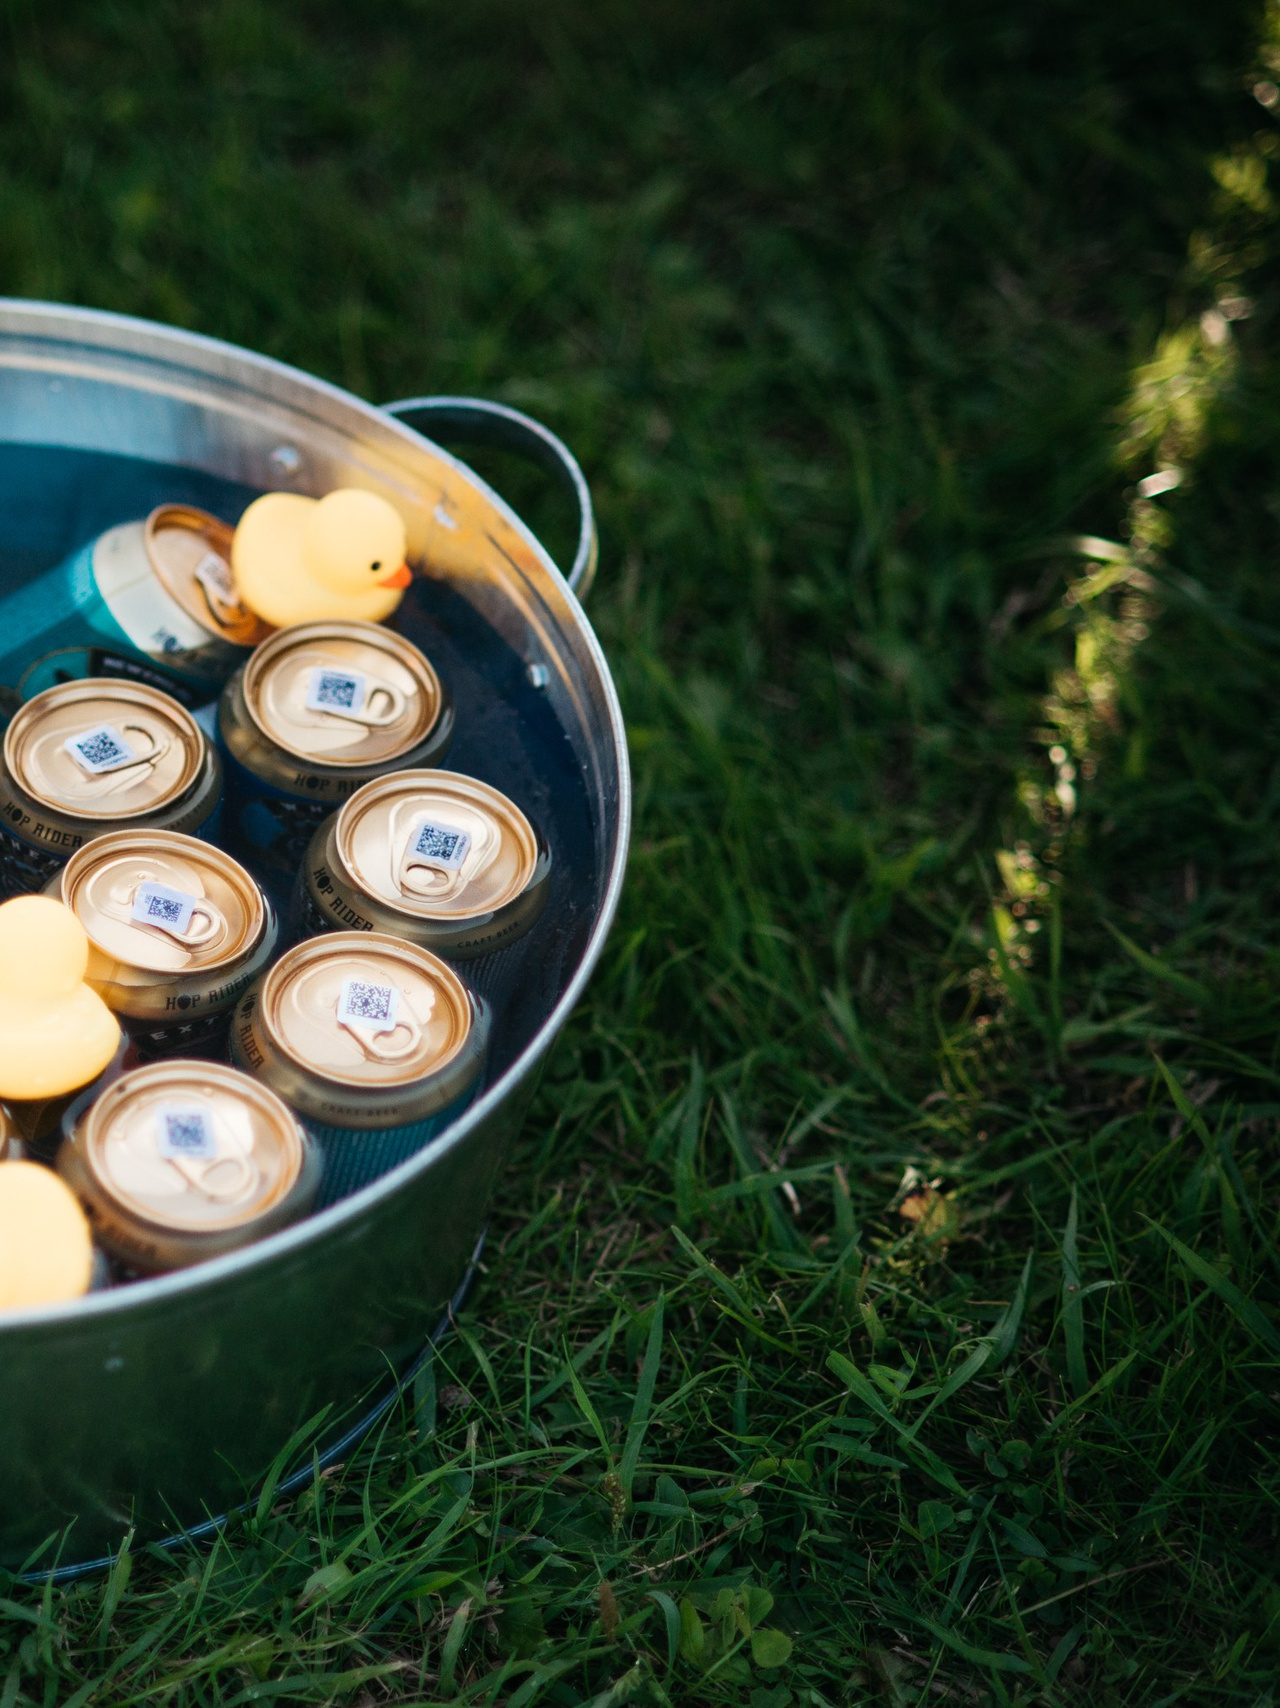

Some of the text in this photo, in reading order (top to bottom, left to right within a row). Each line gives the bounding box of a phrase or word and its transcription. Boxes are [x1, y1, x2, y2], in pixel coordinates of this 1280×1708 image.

[32, 822, 83, 847] RIDER
[329, 896, 375, 932] RIDER
[457, 935, 492, 949] CRAFT
[208, 972, 251, 1004] RIDER
[239, 1024, 265, 1069] RIDER
